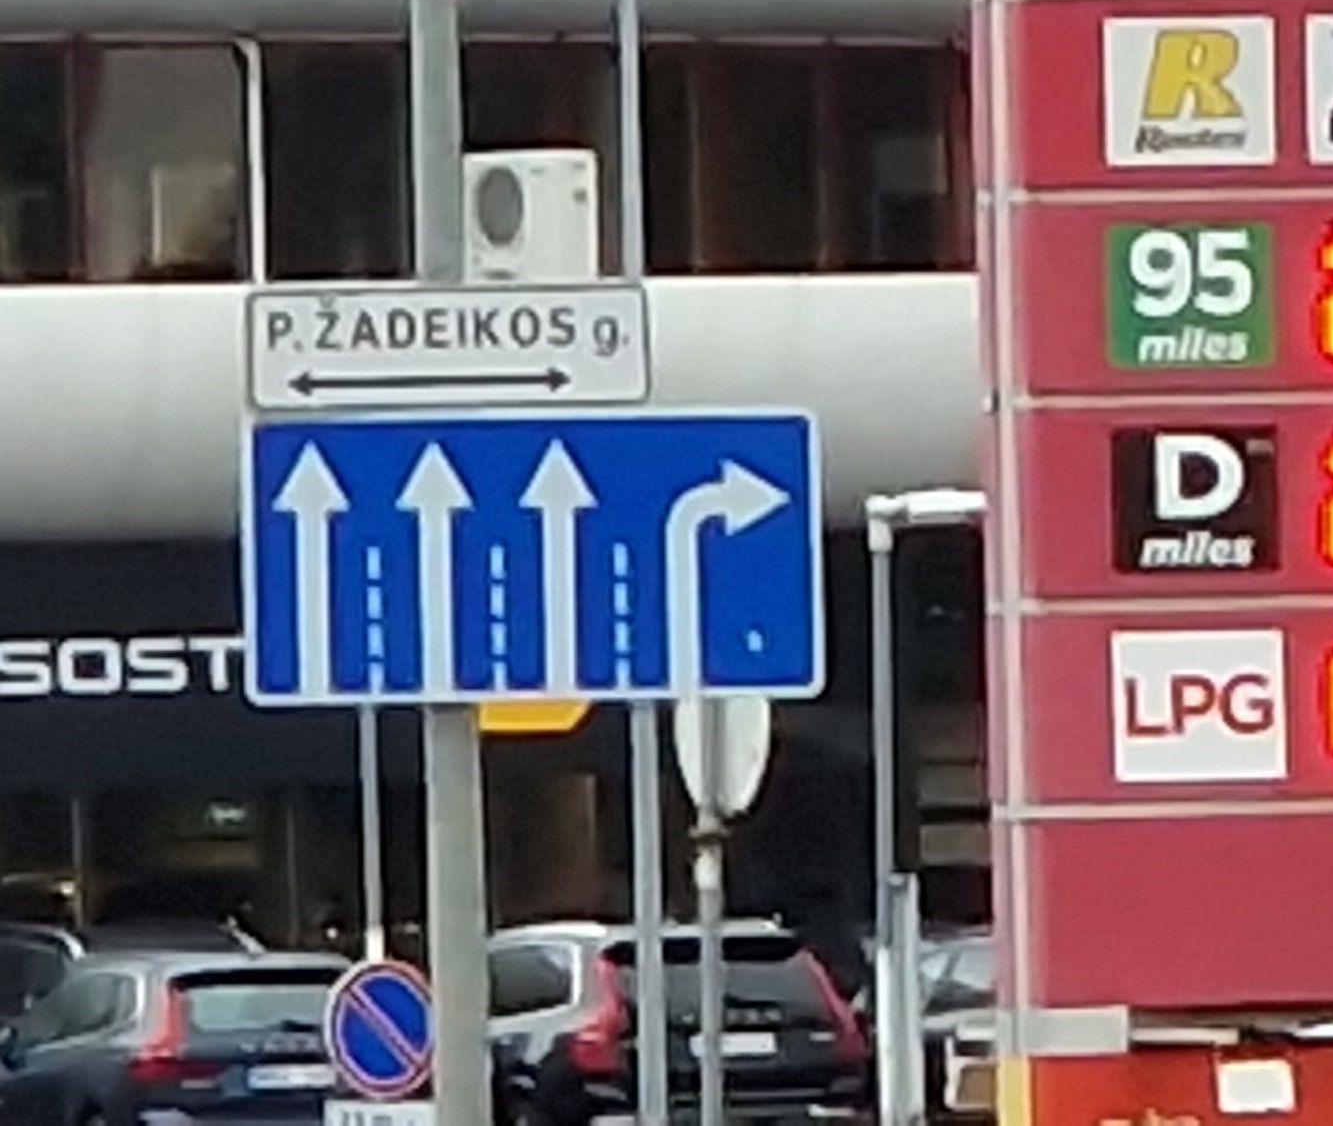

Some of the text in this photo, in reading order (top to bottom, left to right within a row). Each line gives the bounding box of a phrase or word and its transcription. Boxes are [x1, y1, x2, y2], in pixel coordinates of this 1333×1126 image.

[1141, 29, 1245, 119] R
[1130, 229, 1253, 317] 95
[592, 315, 631, 357] g.
[1138, 327, 1251, 364] miles
[1155, 432, 1245, 520] D
[1139, 531, 1255, 568] miles
[0, 635, 244, 696] SOST
[1124, 673, 1275, 738] LPG
